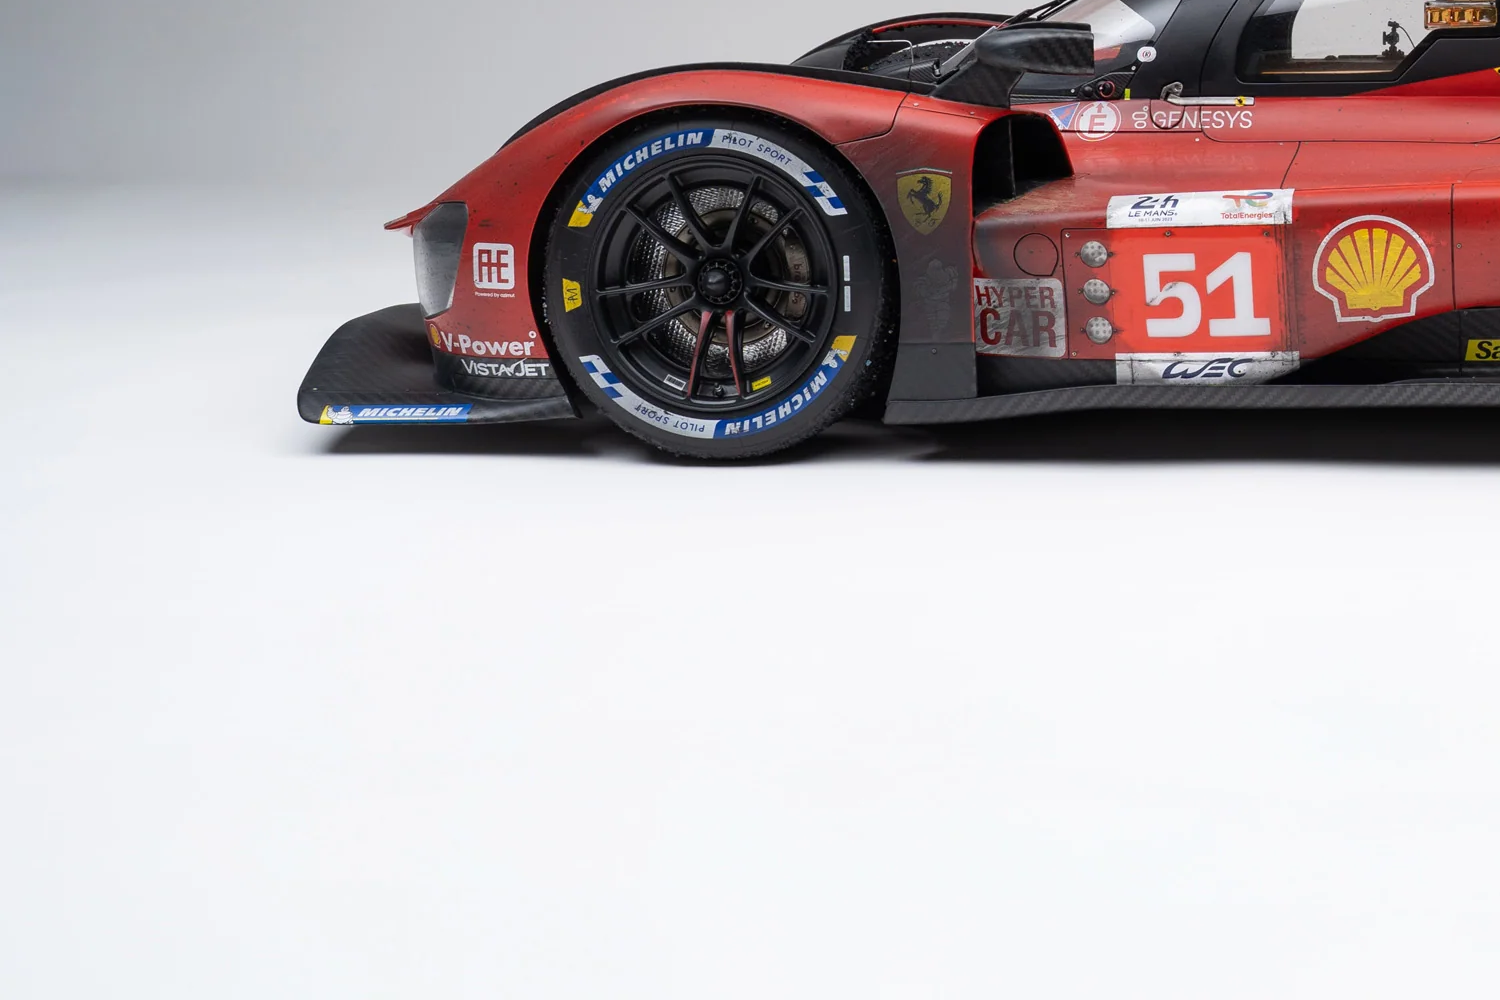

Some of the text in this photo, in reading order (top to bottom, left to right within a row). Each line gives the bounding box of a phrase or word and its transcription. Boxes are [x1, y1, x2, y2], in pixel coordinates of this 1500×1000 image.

[1152, 111, 1253, 129] GENESYS
[598, 131, 704, 193] MICHELIN
[721, 134, 793, 167] PILOT SPORT
[1128, 210, 1141, 218] LE
[1220, 212, 1273, 221] TotalEnergies
[975, 285, 1056, 309] HYPER
[1142, 252, 1272, 338] 51
[980, 307, 1058, 348] CAR
[440, 330, 536, 356] V-Power
[1161, 357, 1253, 379] WEC
[357, 406, 464, 418] MICHELIN
[725, 369, 828, 436] MICHELIN
[633, 402, 706, 433] PILOT SPORT
